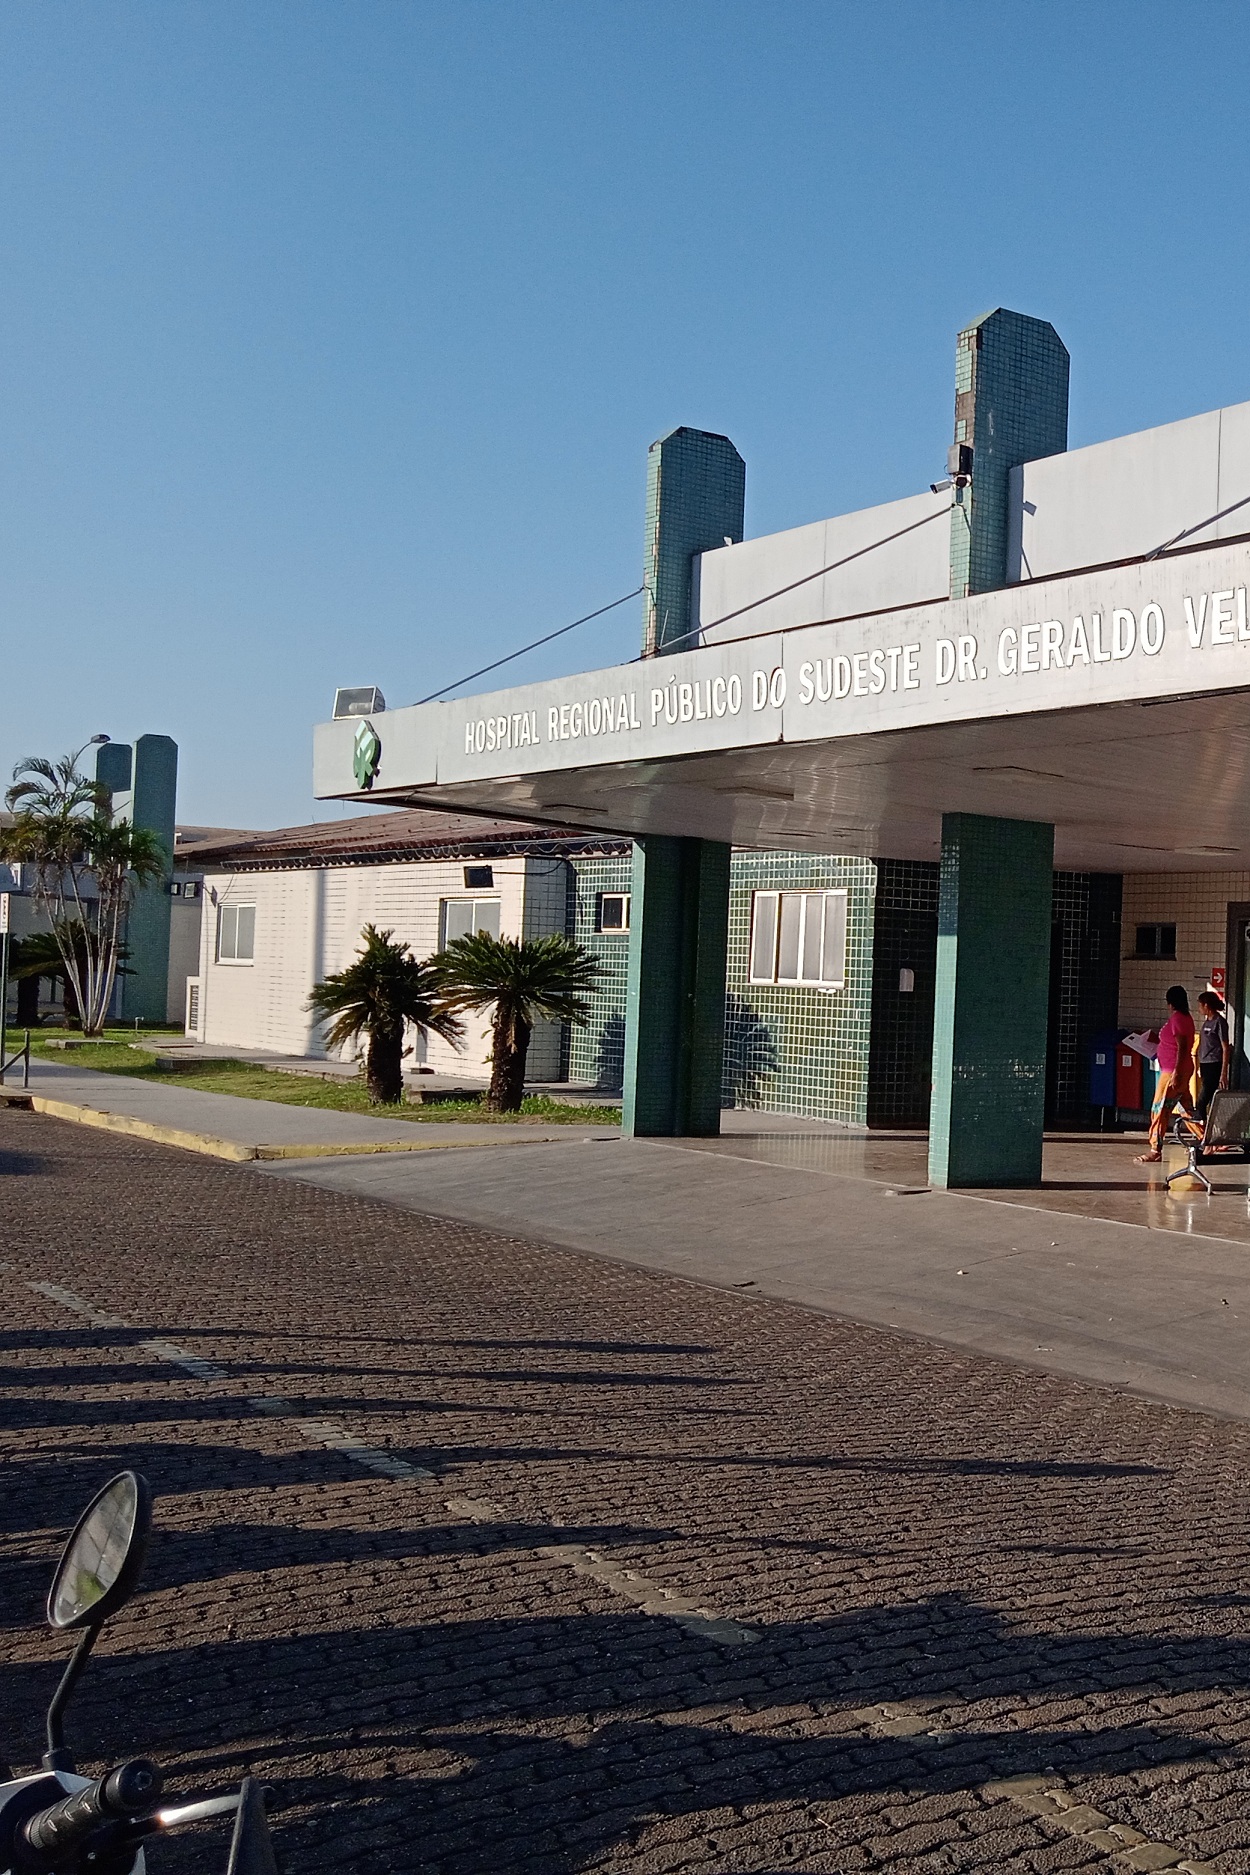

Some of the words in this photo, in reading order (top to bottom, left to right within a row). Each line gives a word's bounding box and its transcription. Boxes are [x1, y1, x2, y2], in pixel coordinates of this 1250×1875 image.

[464, 710, 540, 755] HOSPITAL
[547, 691, 641, 742] REGIONAL
[651, 674, 742, 727] PÚBLICO
[752, 667, 787, 711] DO
[799, 643, 920, 705] SUDESTE
[935, 636, 987, 686] DR.
[997, 602, 1165, 677] GERALDO
